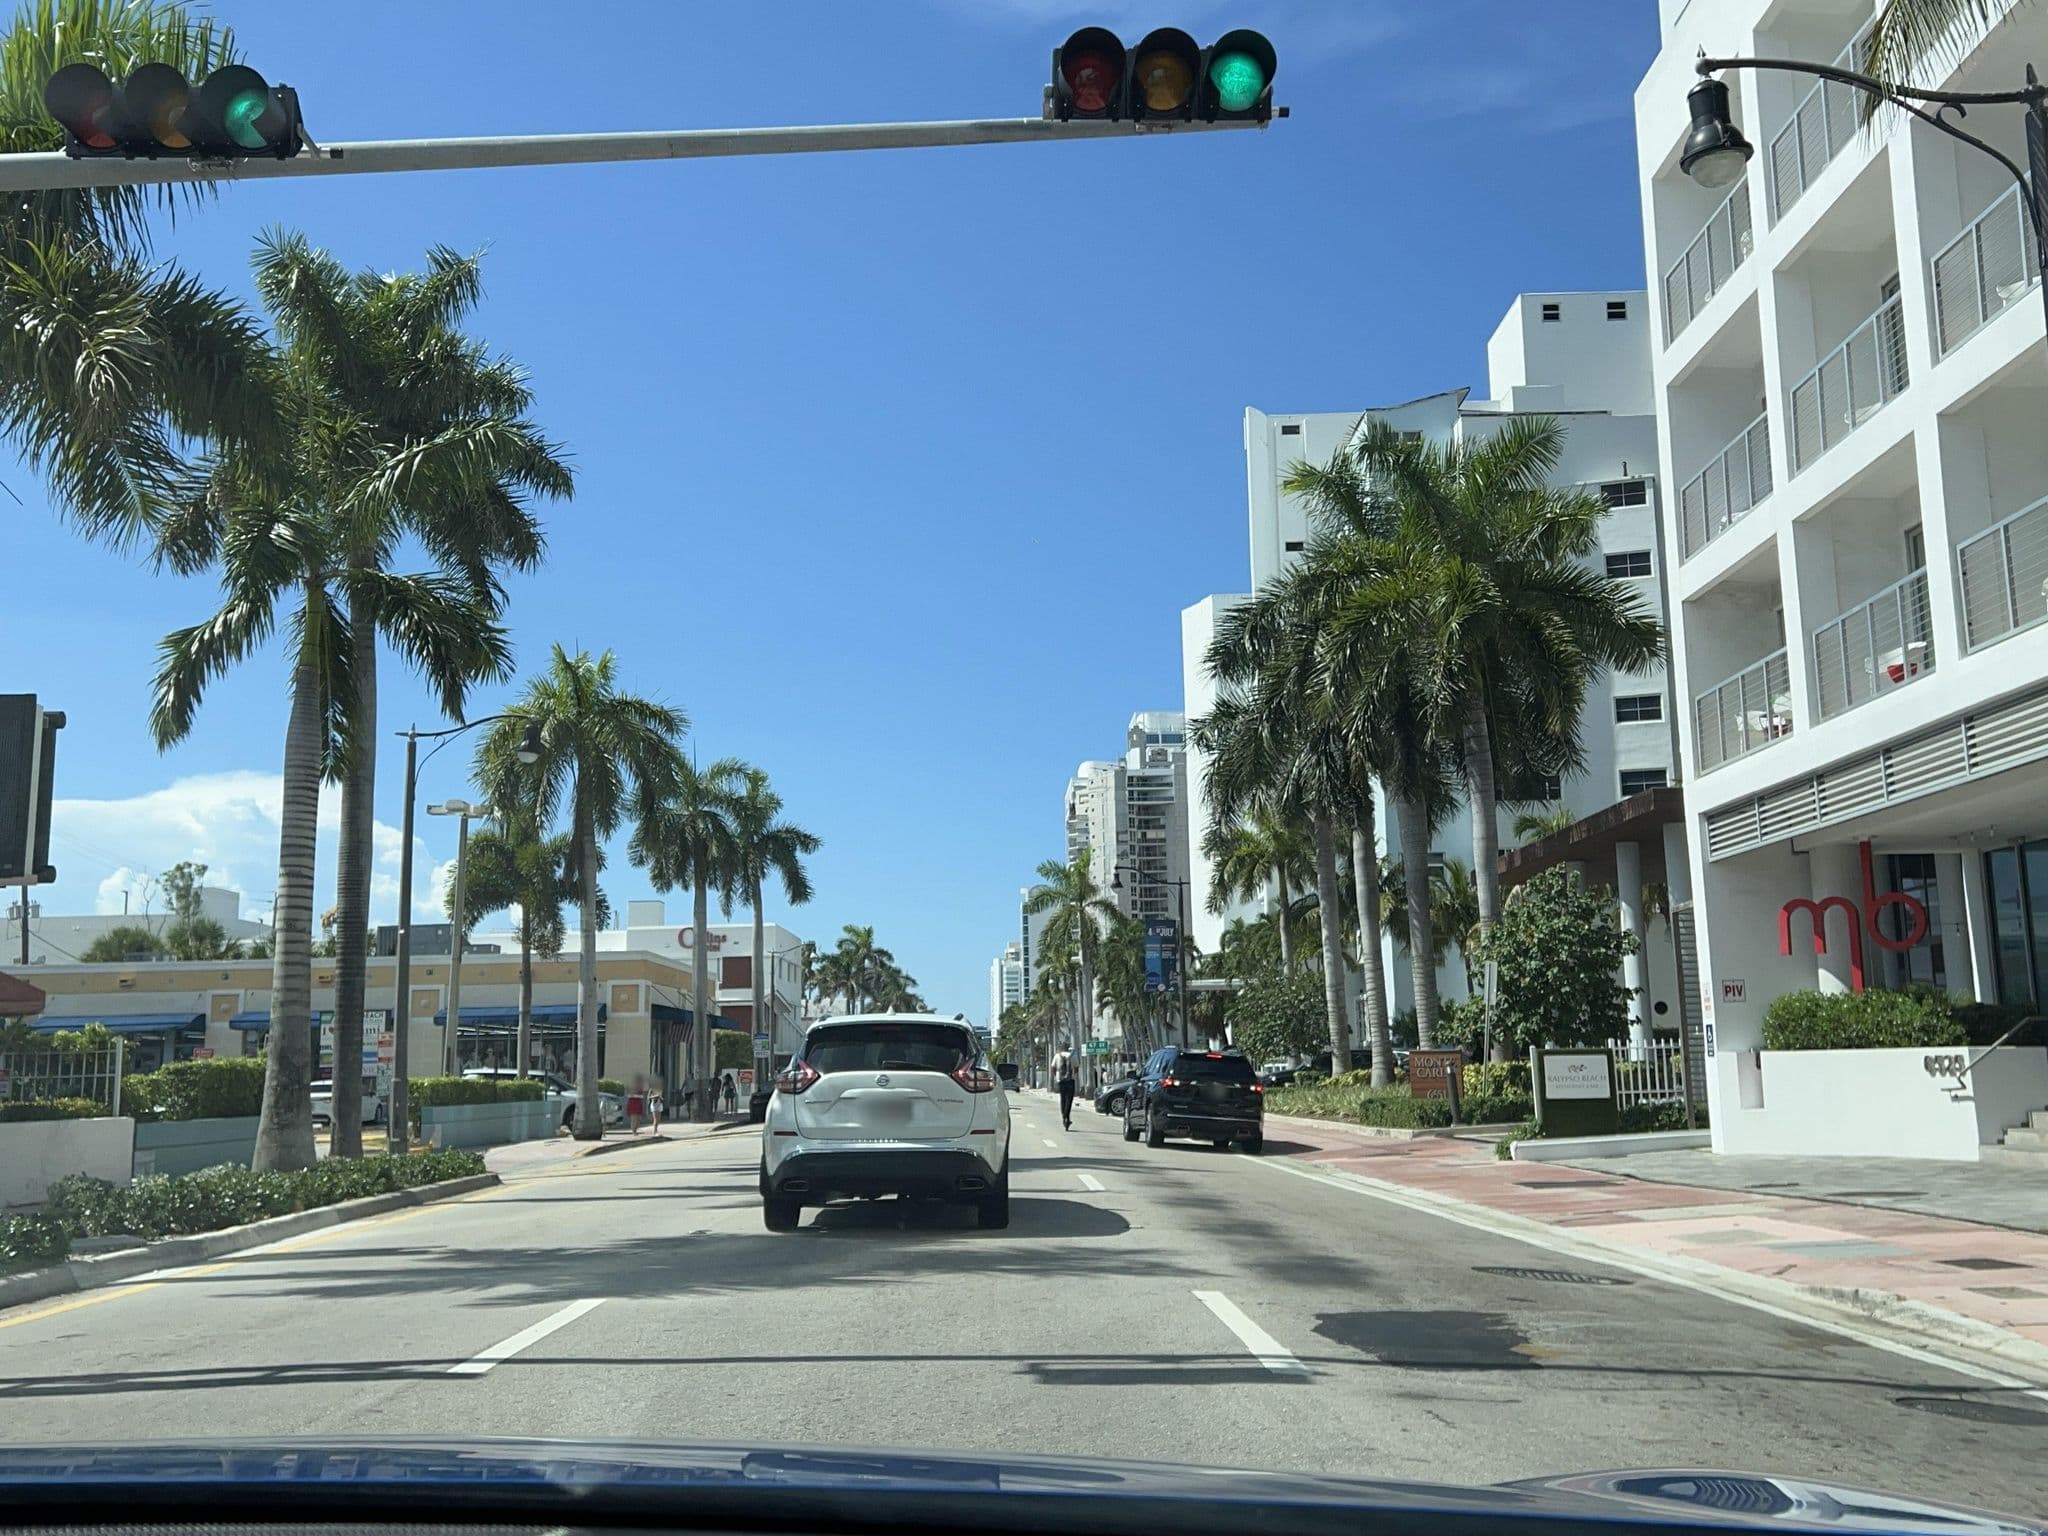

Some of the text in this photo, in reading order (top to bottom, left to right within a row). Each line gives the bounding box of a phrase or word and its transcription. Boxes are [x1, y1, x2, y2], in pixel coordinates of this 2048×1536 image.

[1778, 840, 1928, 996] mb
[678, 927, 727, 949] Clins
[1724, 985, 1743, 997] PIV
